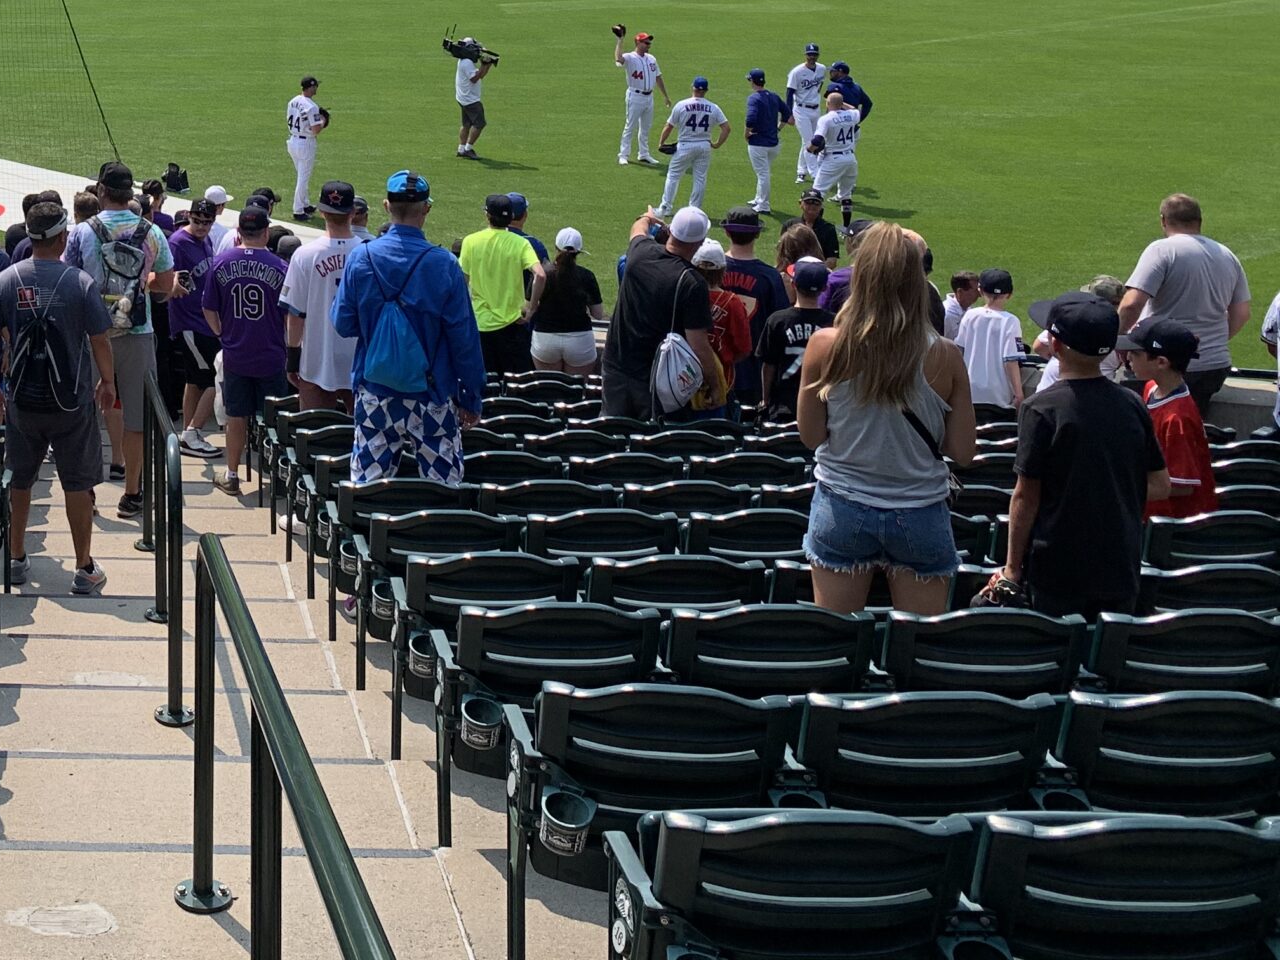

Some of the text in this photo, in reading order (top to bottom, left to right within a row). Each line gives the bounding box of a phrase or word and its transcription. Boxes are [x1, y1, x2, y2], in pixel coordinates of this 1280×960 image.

[631, 70, 644, 81] 44
[685, 102, 713, 114] KIMBREL
[287, 114, 301, 133] 44
[685, 113, 711, 132] 44
[836, 125, 853, 145] 44
[215, 260, 285, 290] BLACKMON
[231, 282, 265, 321] 19
